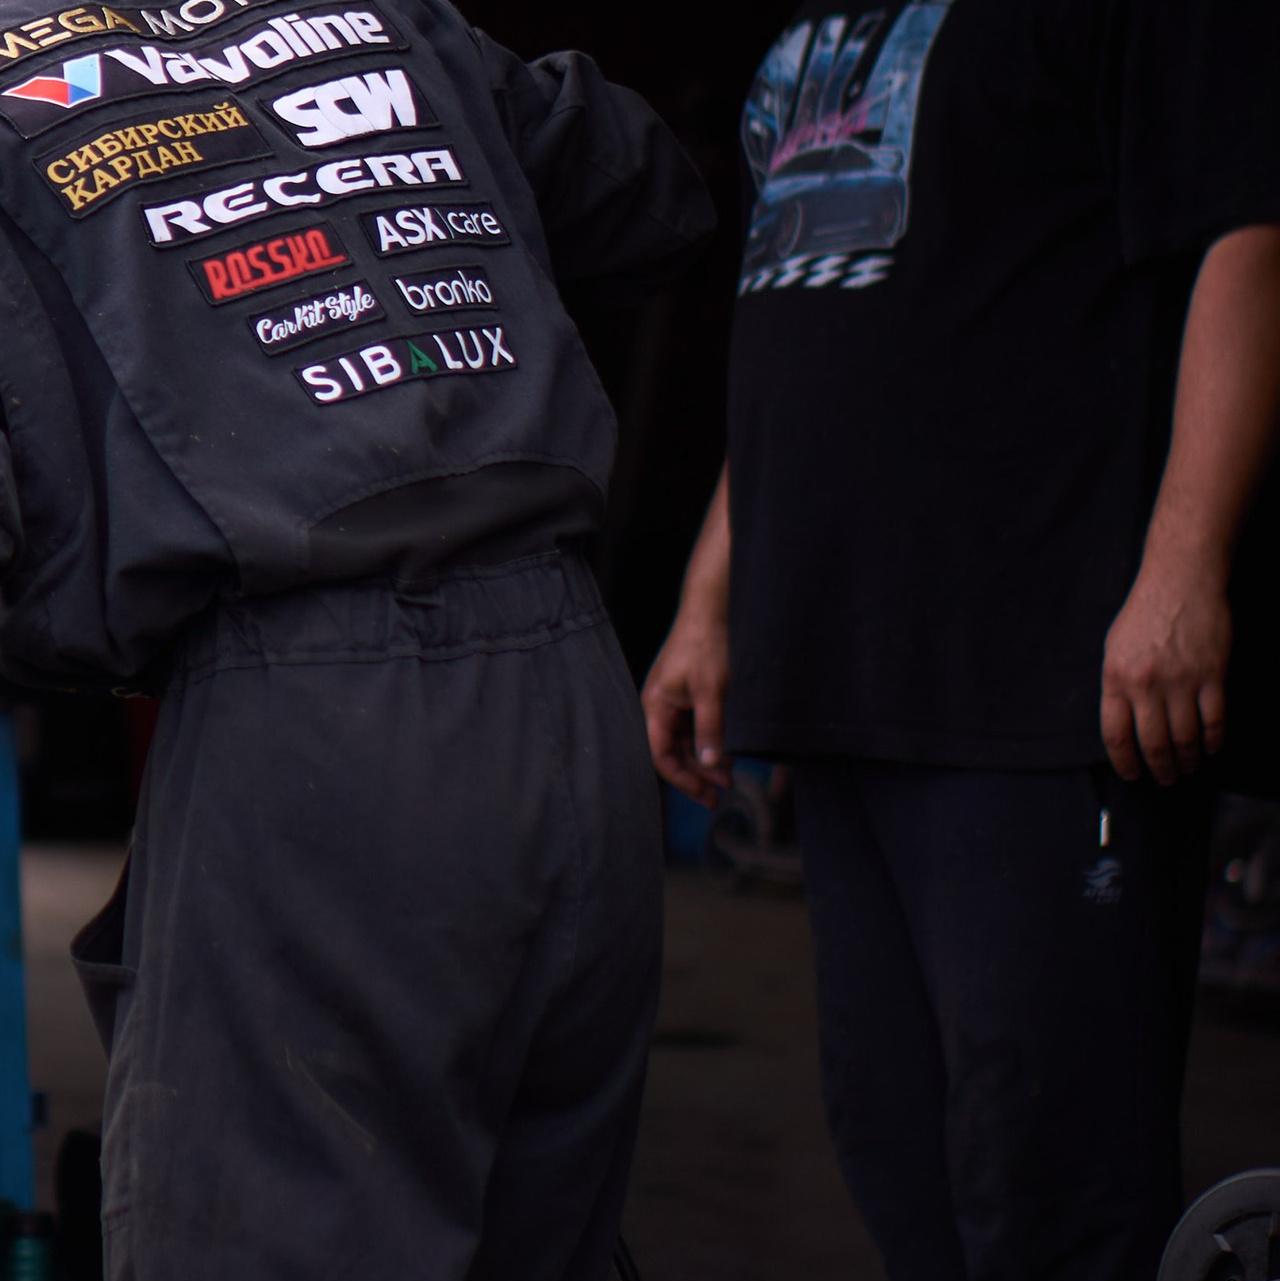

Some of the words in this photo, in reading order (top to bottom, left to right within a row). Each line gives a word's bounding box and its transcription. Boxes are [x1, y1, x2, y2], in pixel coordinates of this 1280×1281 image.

[46, 102, 249, 184] СИБИРСКИЙ
[273, 69, 417, 148] SCW
[61, 141, 204, 211] КАРДАН
[144, 149, 463, 243] RECERA
[395, 270, 492, 310] bronko
[302, 327, 515, 402] SIBALUX
